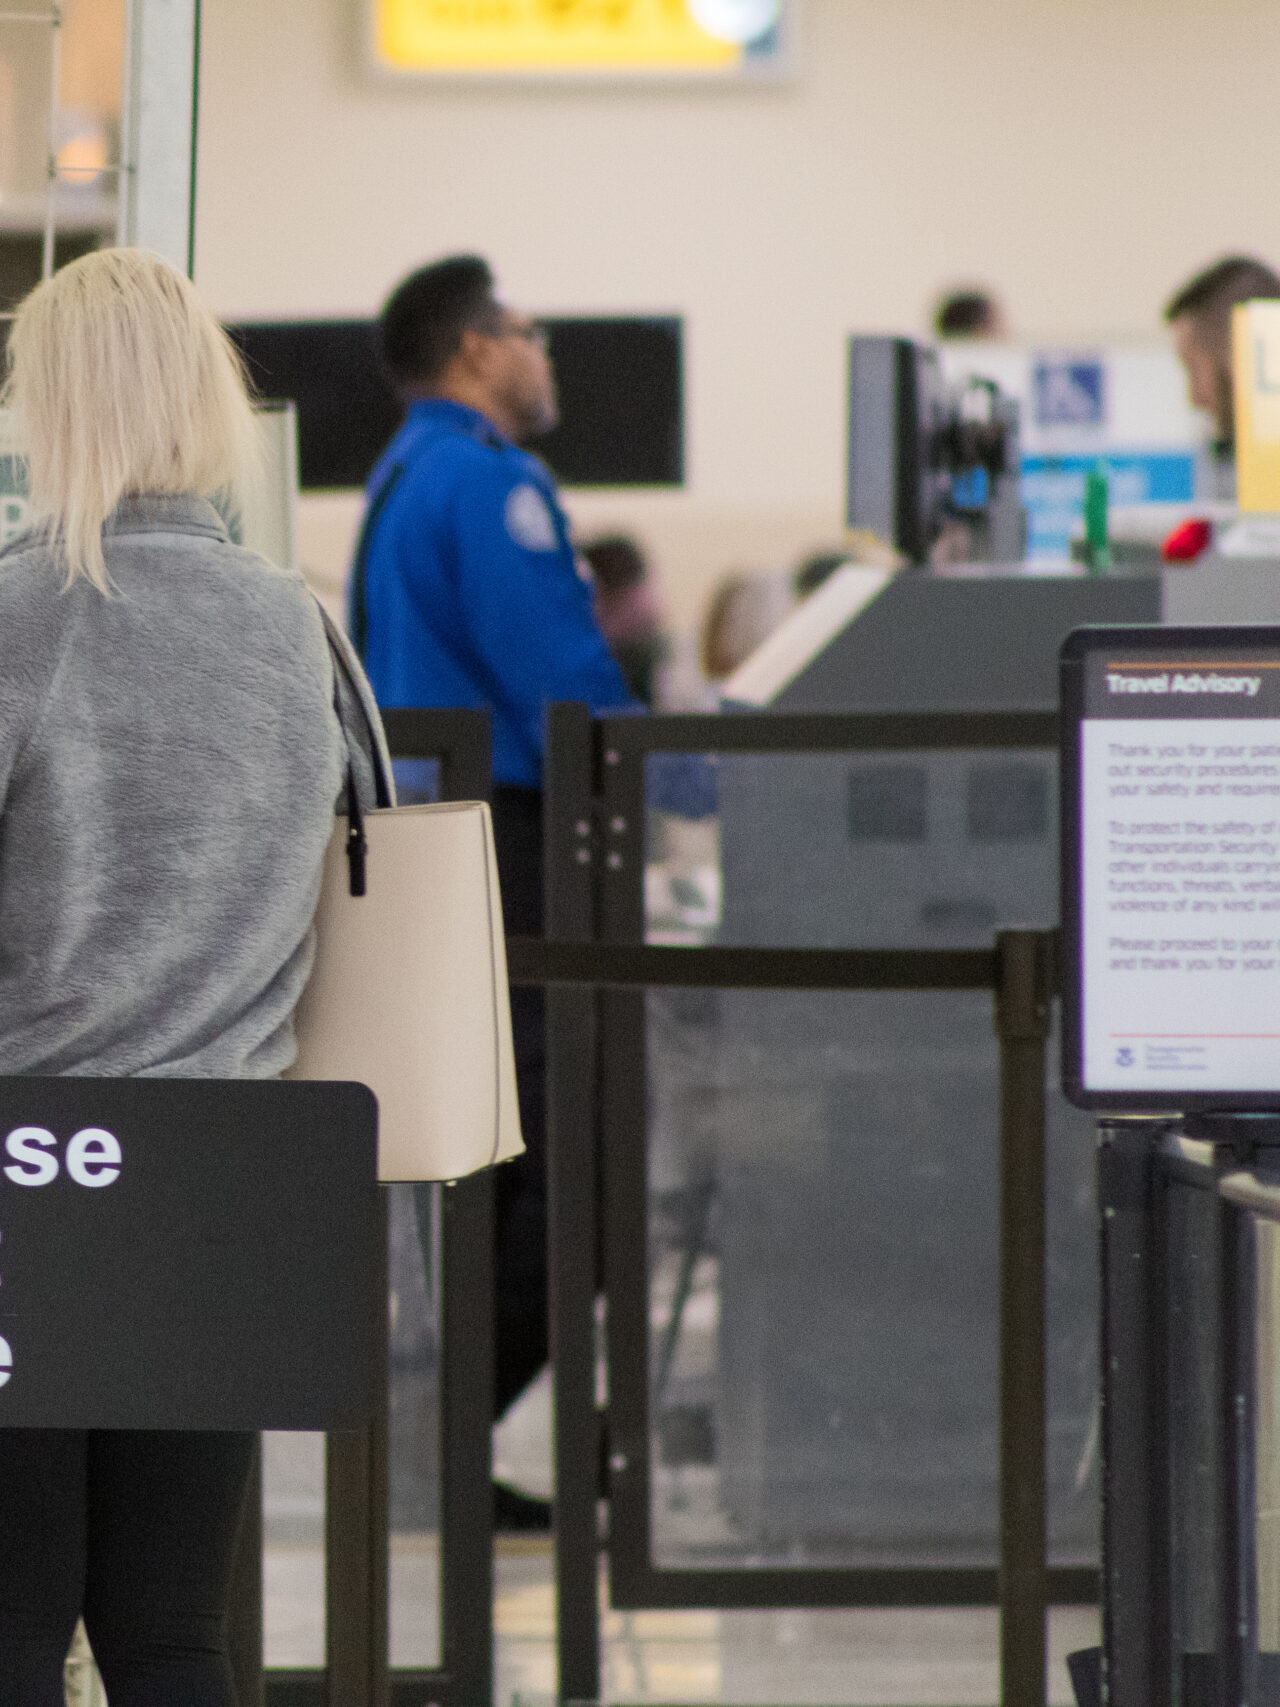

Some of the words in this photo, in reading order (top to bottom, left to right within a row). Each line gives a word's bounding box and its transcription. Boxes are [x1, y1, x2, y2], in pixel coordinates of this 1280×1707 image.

[1106, 672, 1168, 694] Travel
[1171, 672, 1262, 696] Advisory
[1108, 742, 1152, 757] Thank
[1157, 744, 1185, 760] you
[1186, 742, 1207, 757] for
[1214, 744, 1245, 760] your
[1107, 763, 1132, 777] out
[1136, 763, 1193, 779] security
[1109, 784, 1140, 799] your
[1146, 782, 1190, 799] safety
[1195, 782, 1223, 796] and
[1109, 820, 1125, 834] To
[1128, 820, 1180, 837] protect
[1183, 820, 1208, 834] the
[1210, 820, 1256, 837] safety
[1259, 820, 1277, 834] of
[1108, 839, 1216, 857] Transportation
[1218, 839, 1278, 857] Security
[1108, 859, 1146, 873] other
[1150, 859, 1231, 873] individuals
[1109, 897, 1169, 911] violence
[1171, 897, 1189, 911] of
[1191, 899, 1218, 914] any
[1221, 897, 1256, 911] kind
[1109, 937, 1156, 951] Please
[1157, 937, 1219, 954] proceed
[1220, 937, 1237, 951] to
[1239, 939, 1274, 954] your
[1109, 956, 1138, 970] and
[1138, 956, 1181, 970] thank
[1185, 958, 1213, 973] you
[1214, 956, 1237, 970] for
[1241, 958, 1275, 973] your
